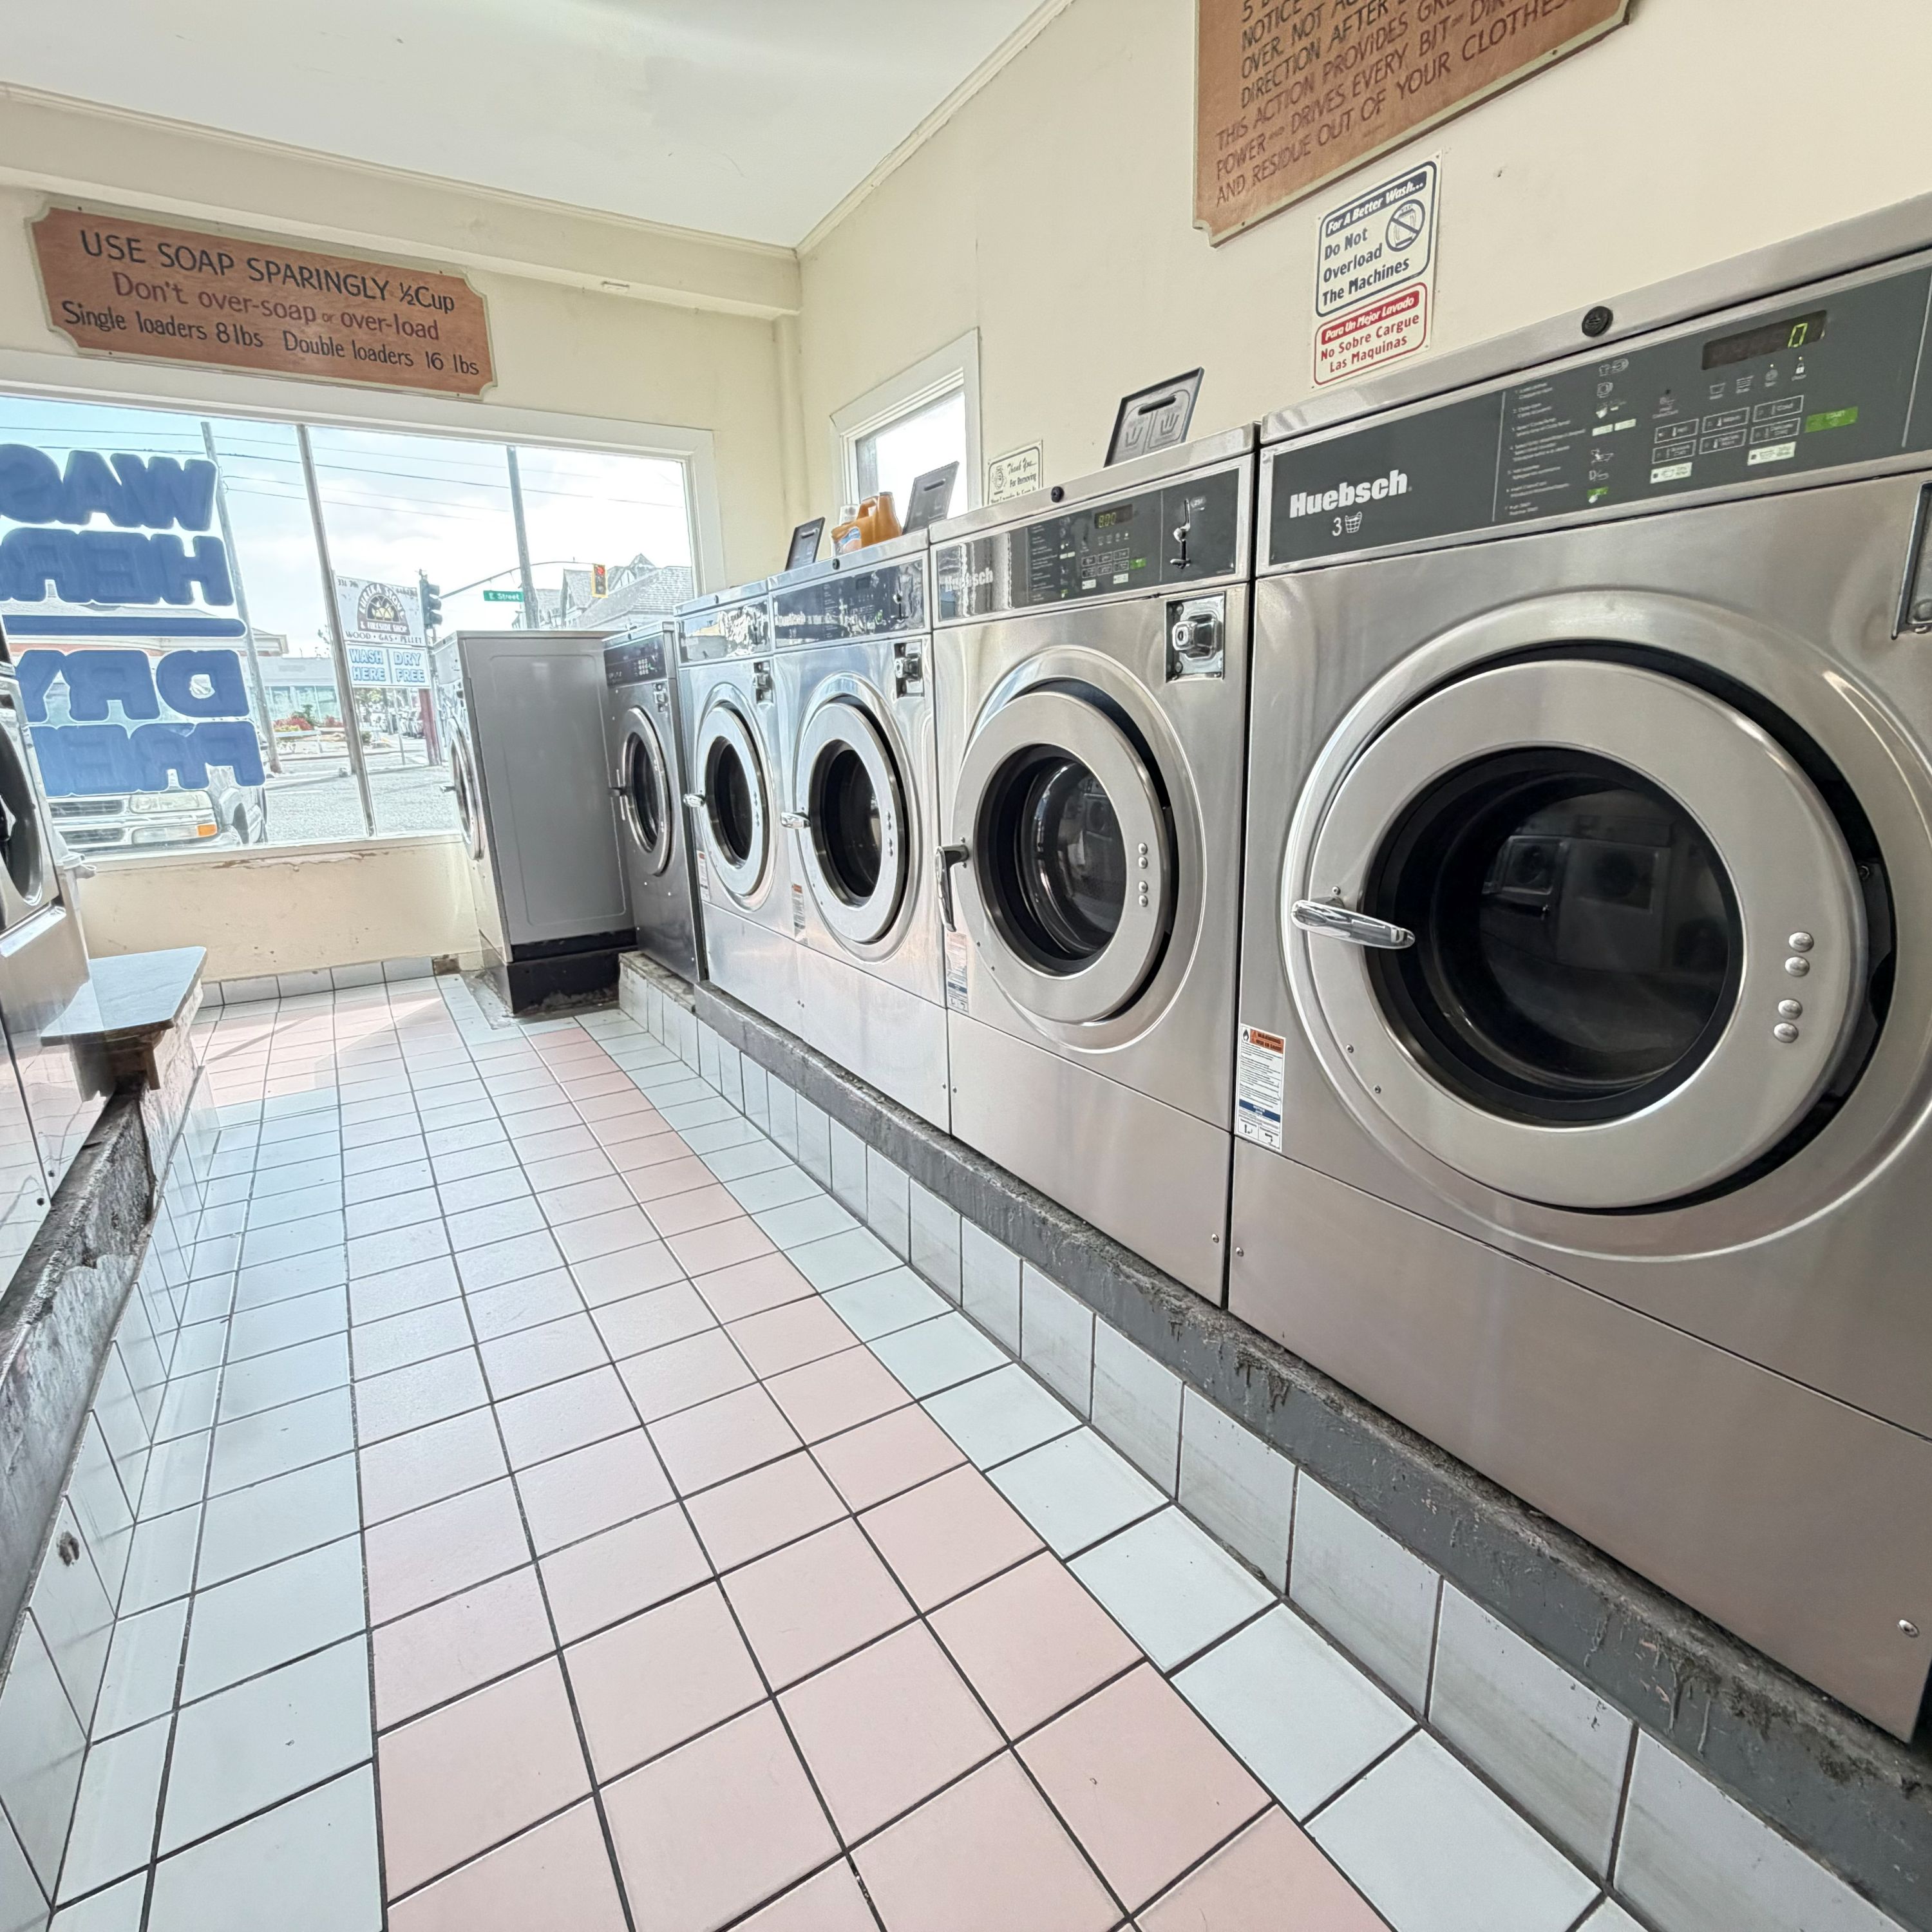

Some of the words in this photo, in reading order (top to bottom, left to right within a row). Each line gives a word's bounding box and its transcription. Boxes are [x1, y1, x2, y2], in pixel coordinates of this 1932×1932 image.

[1242, 0, 1302, 52] NOTICE
[1242, 37, 1283, 79] OVER
[1291, 4, 1325, 46] NOT
[1242, 37, 1321, 108] DIRECTION
[1327, 0, 1388, 52] AFTER
[1216, 117, 1248, 151] THIS
[1253, 71, 1314, 129] ACTION
[1322, 11, 1408, 84] PROVIDES
[1217, 132, 1266, 180] POWER
[1291, 83, 1346, 135] DRIVES
[1352, 43, 1408, 97] EVERY
[1419, 15, 1451, 57] BIT
[1217, 174, 1245, 208] AND
[1252, 133, 1311, 187] RESIDUE
[1318, 108, 1354, 147] OUT
[1360, 88, 1387, 122] OF
[1397, 52, 1451, 100] YOUR
[1327, 216, 1343, 234] For
[1343, 212, 1352, 227] A
[1352, 196, 1383, 223] Better
[82, 230, 146, 263] USE
[158, 242, 234, 276] SOAP
[248, 258, 389, 301] SPARINGLY
[1323, 243, 1383, 283] Overload
[1325, 244, 1340, 261] Do
[1345, 228, 1368, 251] Not
[1323, 287, 1345, 307] The
[1349, 258, 1410, 295] Machines
[114, 272, 188, 305] Don't
[200, 292, 316, 325] over-soap
[323, 312, 335, 321] or
[341, 311, 439, 341] over-load
[1325, 327, 1343, 341] Para
[1345, 321, 1356, 332] Un
[1357, 311, 1381, 329] Mejor
[1382, 296, 1415, 316] Lavado
[63, 301, 128, 333] Single
[136, 310, 207, 341] loaders
[283, 329, 345, 359] Double
[352, 340, 414, 367] loaders
[425, 352, 444, 371] 16
[454, 354, 480, 376] lbs
[1321, 347, 1335, 362] No
[1338, 333, 1371, 353] Sobre
[1376, 315, 1420, 340] Cargue
[1330, 359, 1347, 374] Las
[1351, 335, 1408, 365] Maquinas
[1290, 469, 1408, 518] Huebsch
[1332, 517, 1342, 536] 3
[359, 583, 382, 614] EUREKA
[345, 631, 372, 640] WOOD
[400, 636, 422, 645] PELLET
[349, 649, 384, 665] WASH
[393, 652, 421, 667] DRY
[352, 667, 386, 682] HERE
[395, 668, 426, 683] FREE
